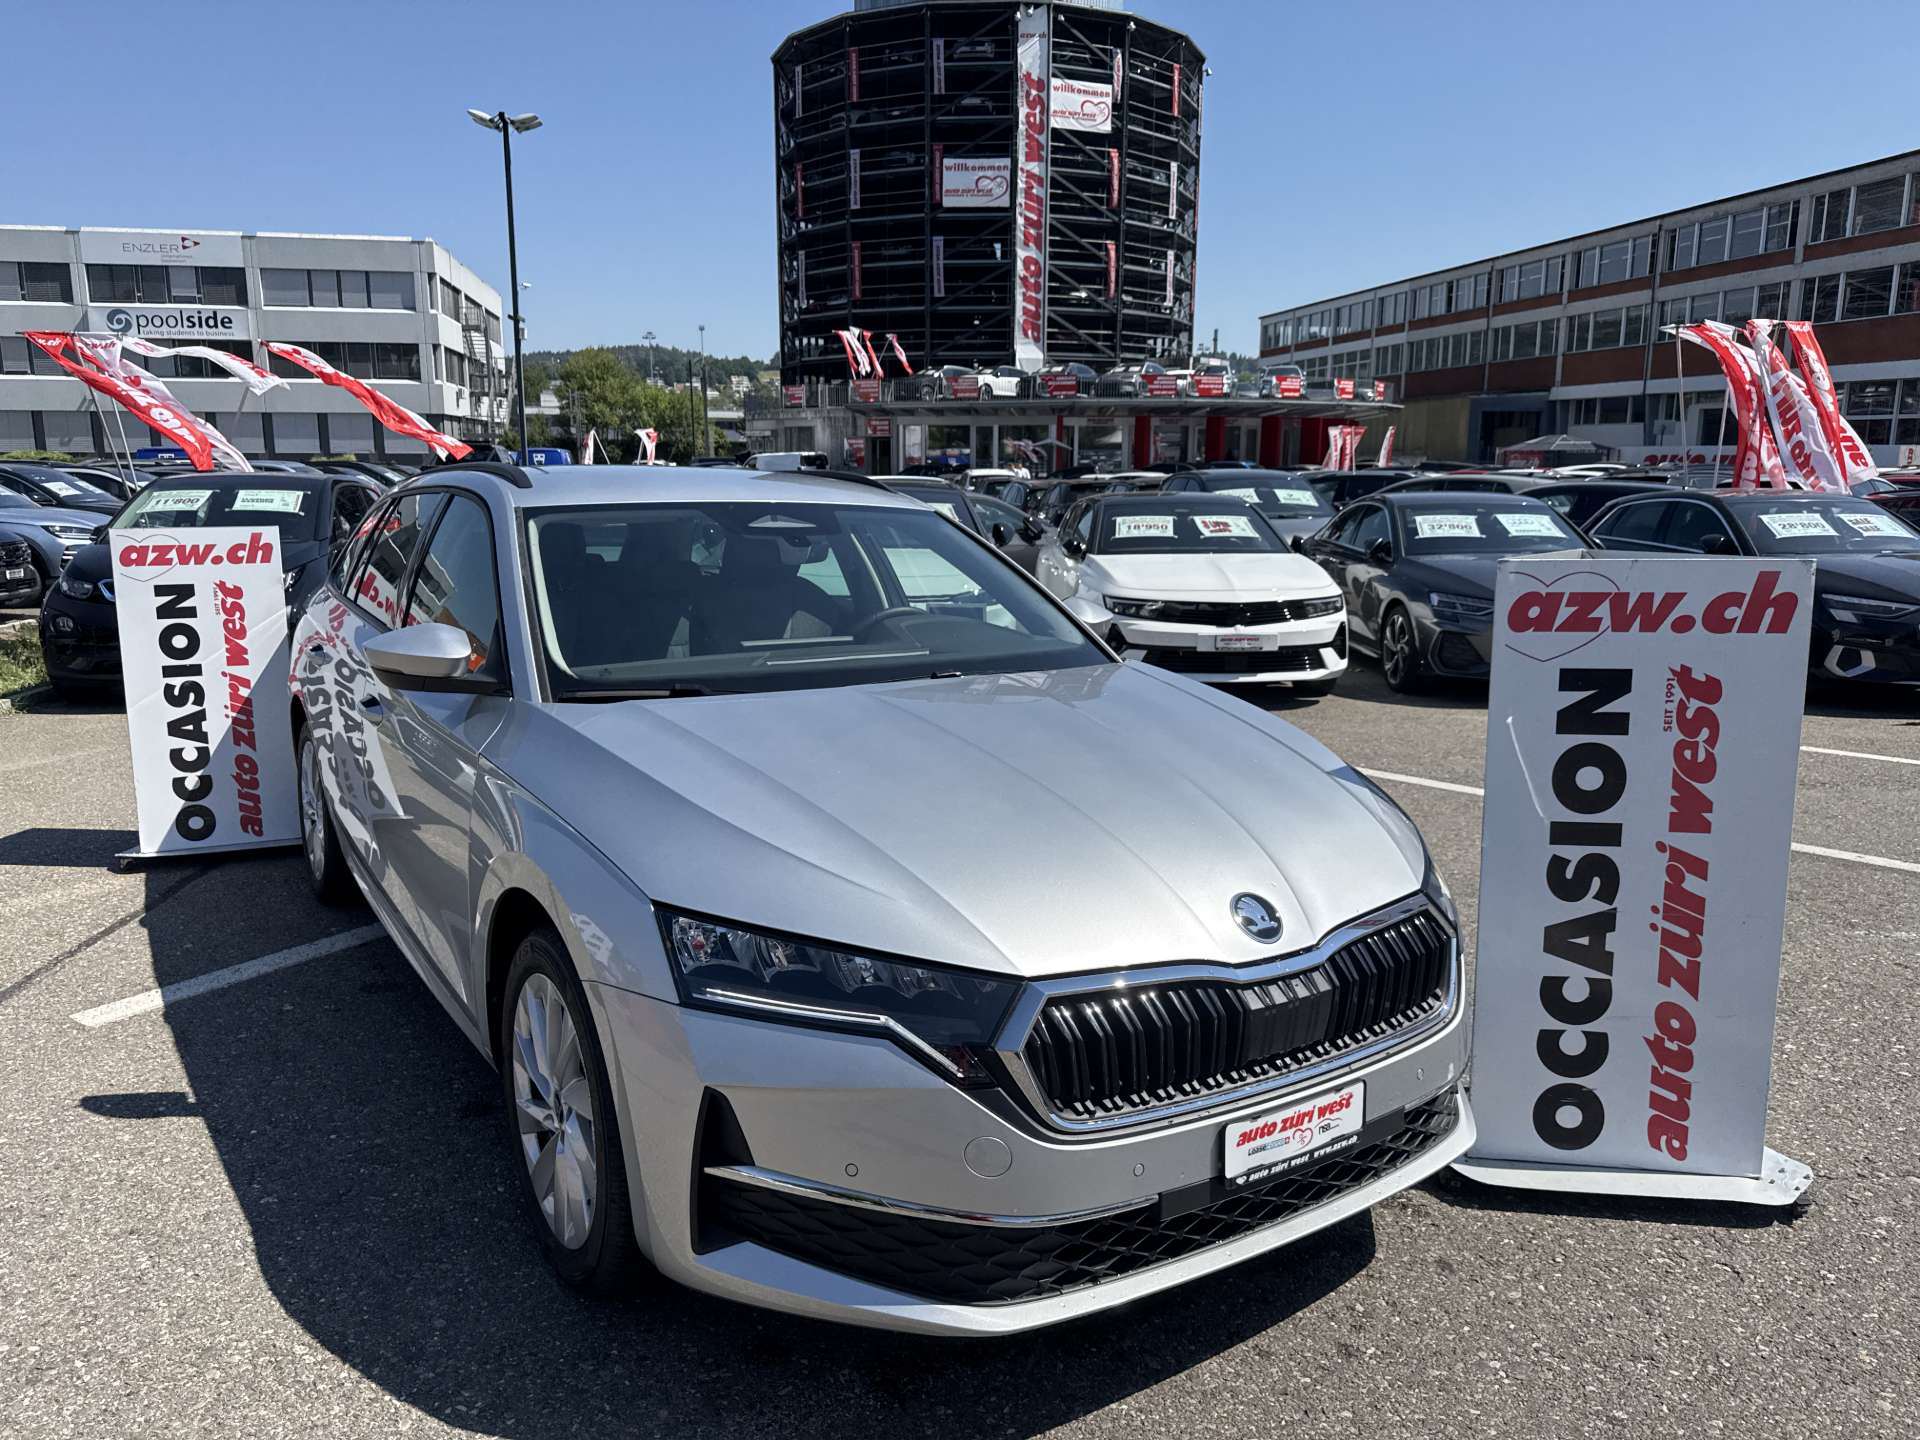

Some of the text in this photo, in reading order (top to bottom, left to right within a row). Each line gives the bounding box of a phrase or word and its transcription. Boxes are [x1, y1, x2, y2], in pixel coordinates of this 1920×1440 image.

[1052, 83, 1110, 97] willkommen
[945, 163, 1008, 171] willkommen
[1018, 71, 1046, 343] auto züri west
[122, 242, 179, 253] ENZLER
[136, 309, 233, 335] poolside
[142, 329, 165, 337] taking
[154, 497, 200, 506] 11'800
[1778, 522, 1825, 530] 28'800
[119, 532, 273, 567] azw.ch
[213, 602, 221, 616] SEIT
[1507, 570, 1799, 635] azw.ch
[153, 583, 217, 842] OCCASION
[213, 580, 264, 837] auto züri west
[1663, 677, 1676, 733] SEIT 1991
[1532, 667, 1634, 1151] OCCASION
[1642, 663, 1723, 1162] auto züri west
[1236, 1091, 1354, 1148] auto züri west
[1248, 1168, 1269, 1182] auto
[1271, 1160, 1289, 1174] züri
[1290, 1153, 1310, 1167] west
